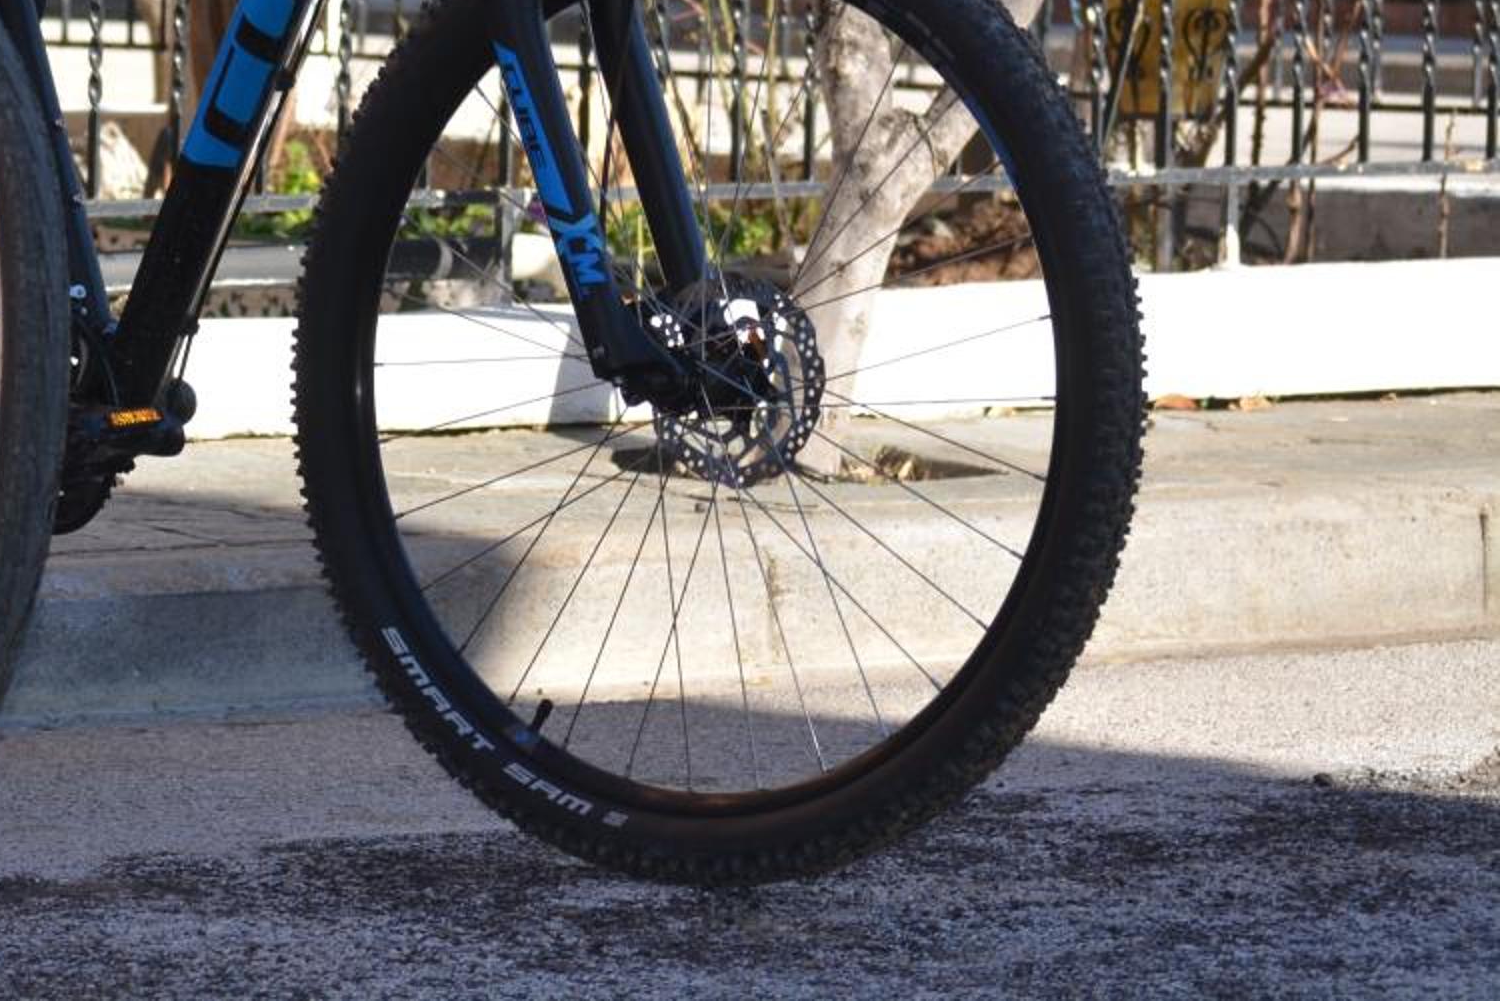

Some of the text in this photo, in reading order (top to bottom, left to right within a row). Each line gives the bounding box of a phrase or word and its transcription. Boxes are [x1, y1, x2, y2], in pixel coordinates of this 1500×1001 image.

[548, 212, 610, 287] XCM
[381, 626, 595, 816] SMART SAM
